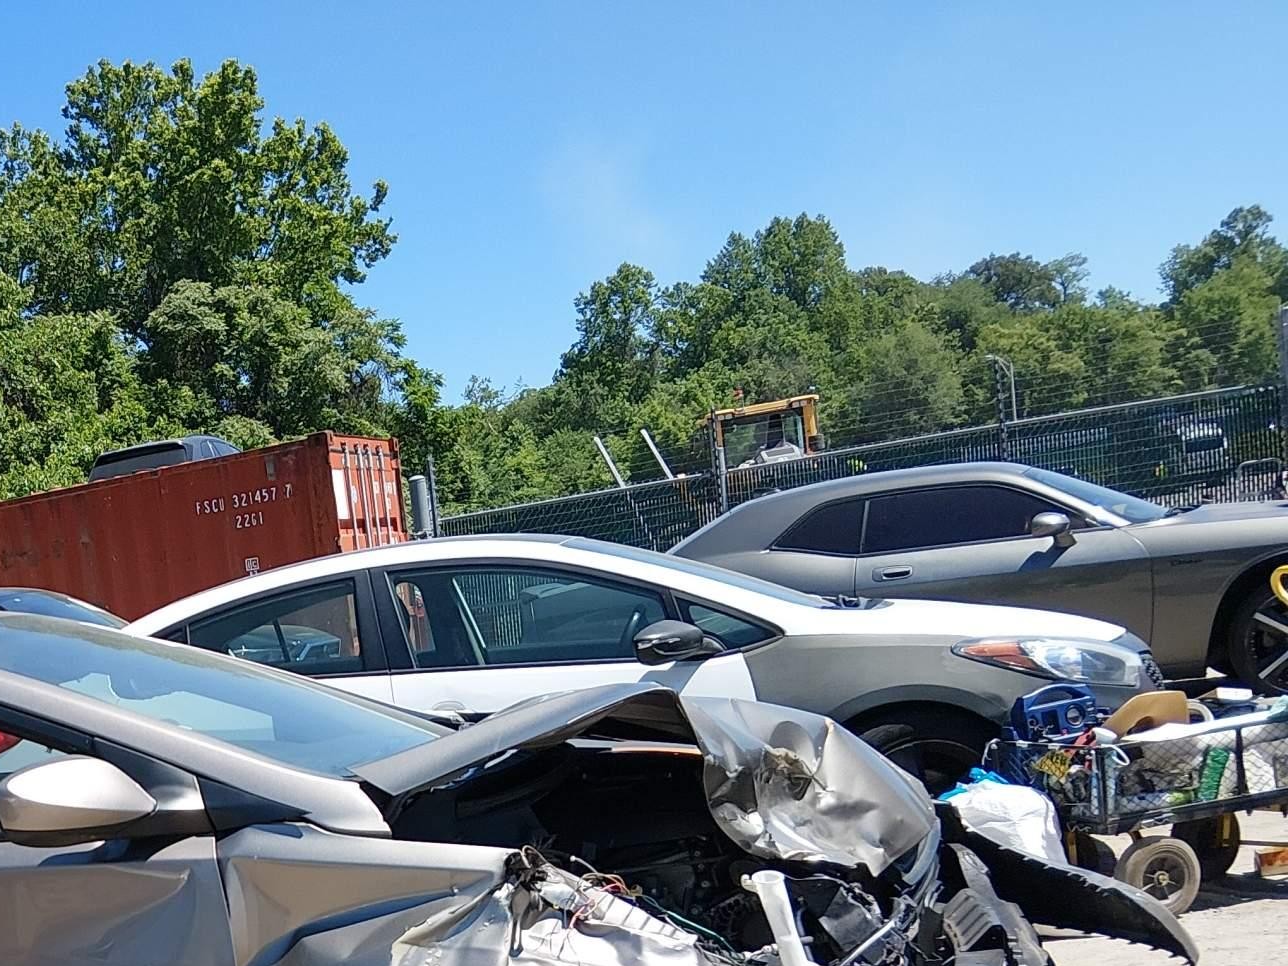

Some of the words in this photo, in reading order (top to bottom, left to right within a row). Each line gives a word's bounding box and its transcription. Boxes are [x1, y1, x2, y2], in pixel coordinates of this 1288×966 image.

[196, 498, 225, 515] FSCU
[232, 487, 277, 508] 321457
[284, 483, 293, 499] 7
